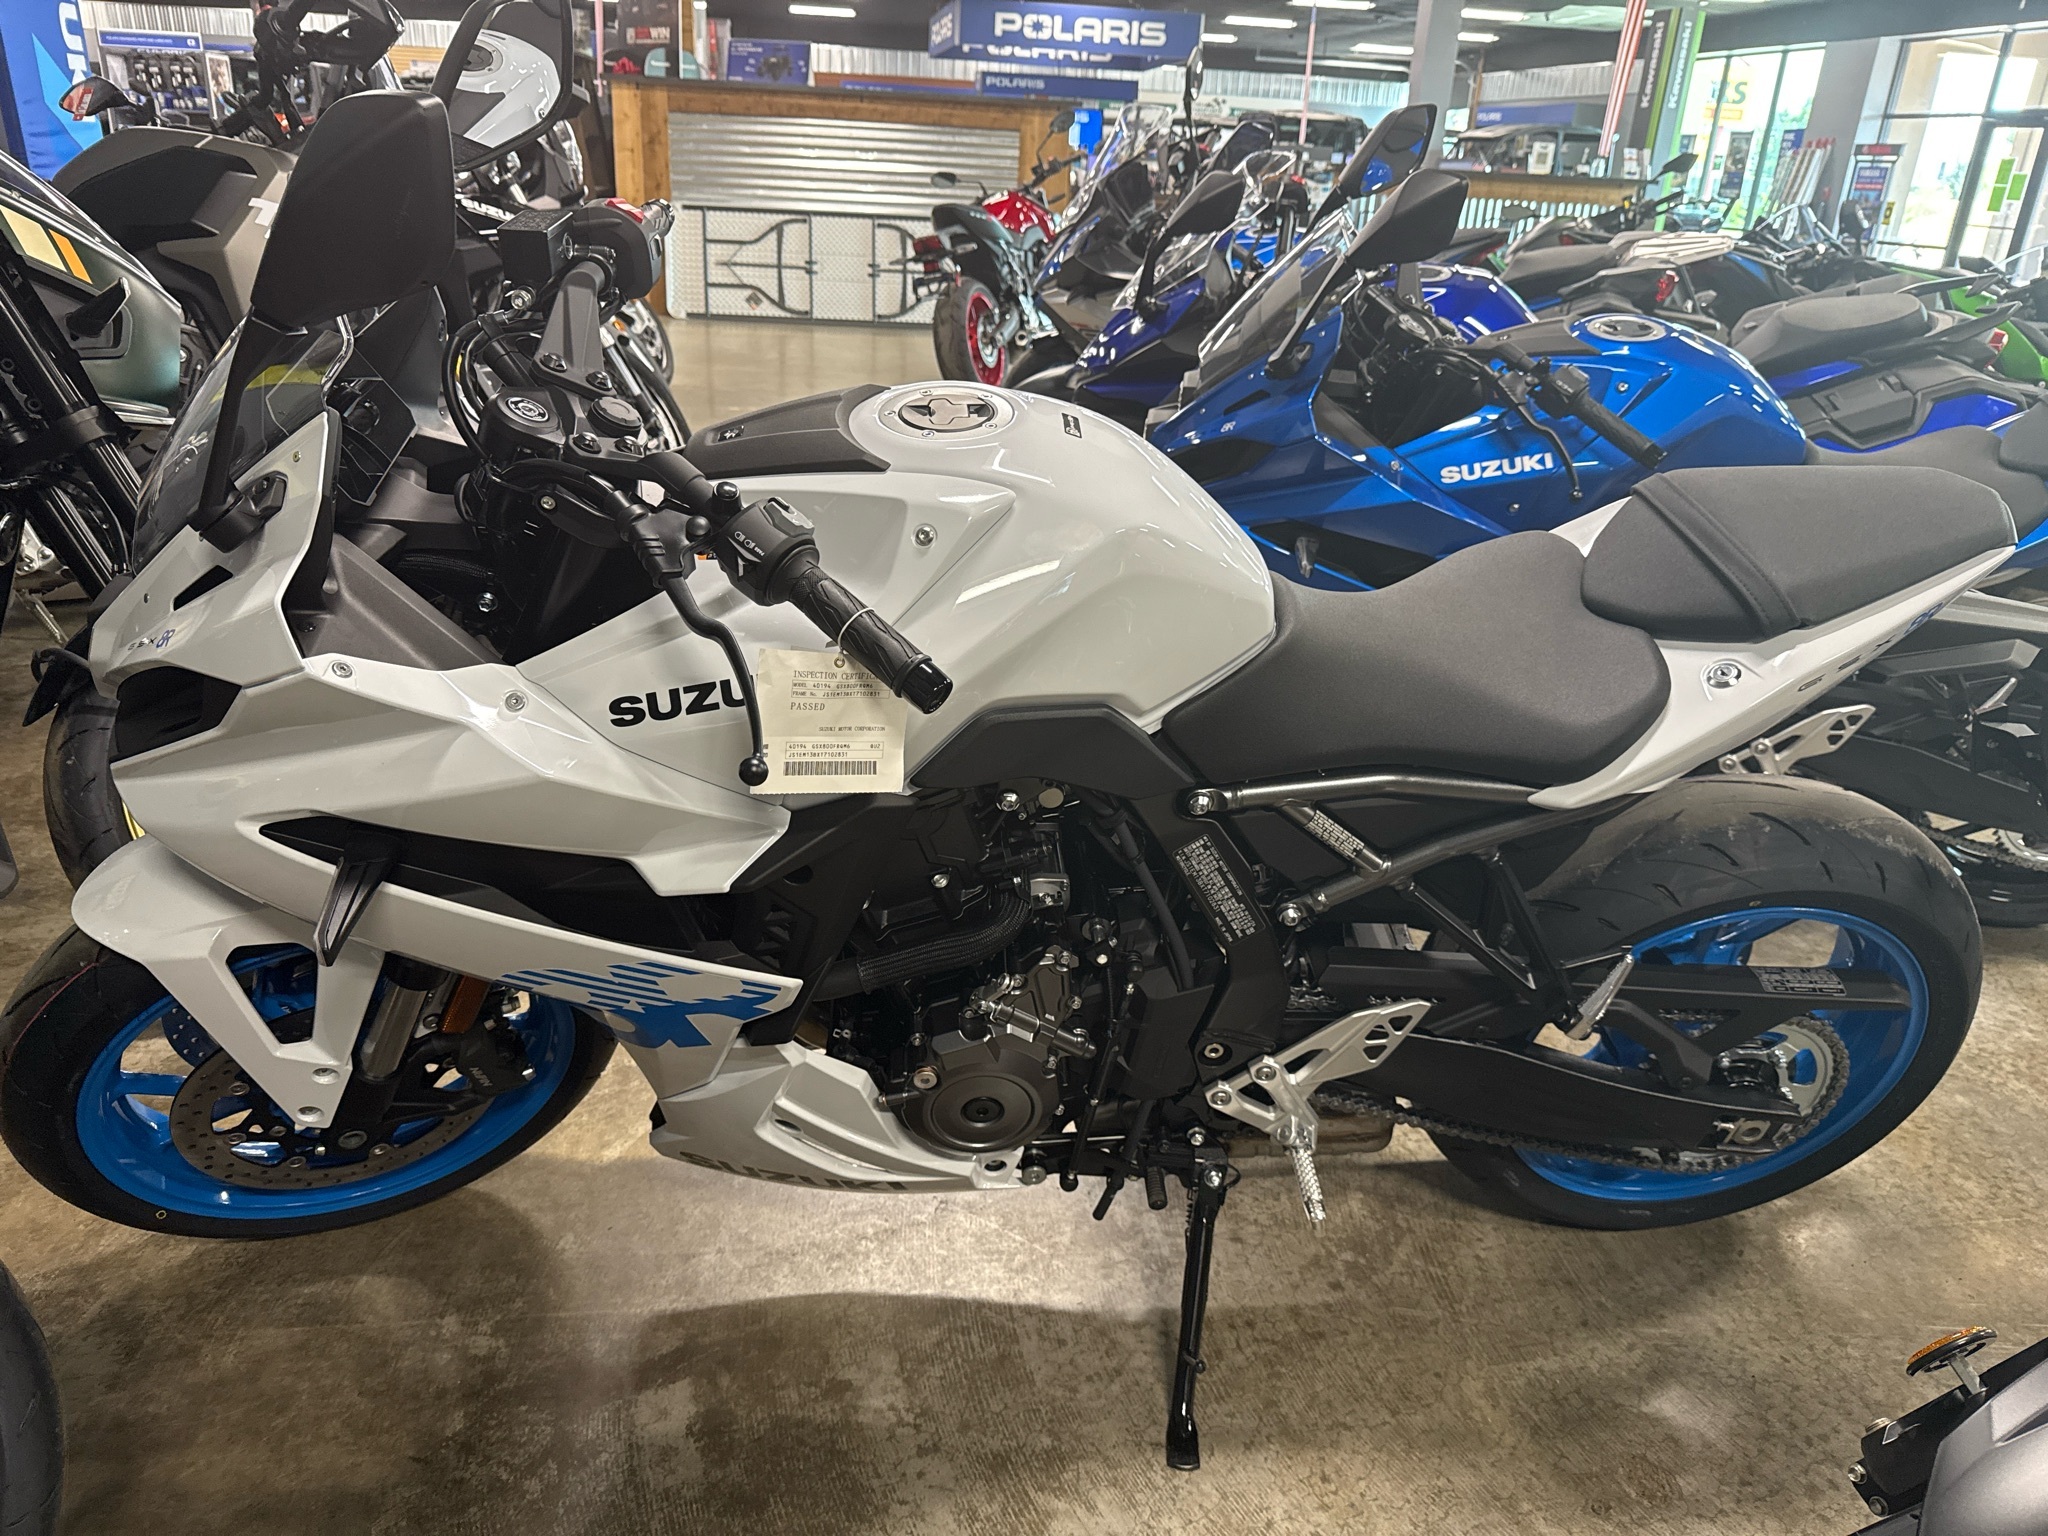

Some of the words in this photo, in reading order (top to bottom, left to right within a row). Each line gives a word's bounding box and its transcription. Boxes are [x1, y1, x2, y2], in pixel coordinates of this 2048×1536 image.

[994, 12, 1167, 47] POLARIS
[1640, 21, 1665, 108] Kawasaki
[1668, 21, 1692, 108] Kawasaki
[986, 76, 1046, 90] POLARIS
[1440, 452, 1554, 484] SUZUKI
[793, 670, 838, 680] INSPECTION
[608, 677, 753, 728] SUZU
[790, 702, 825, 711] PASSED
